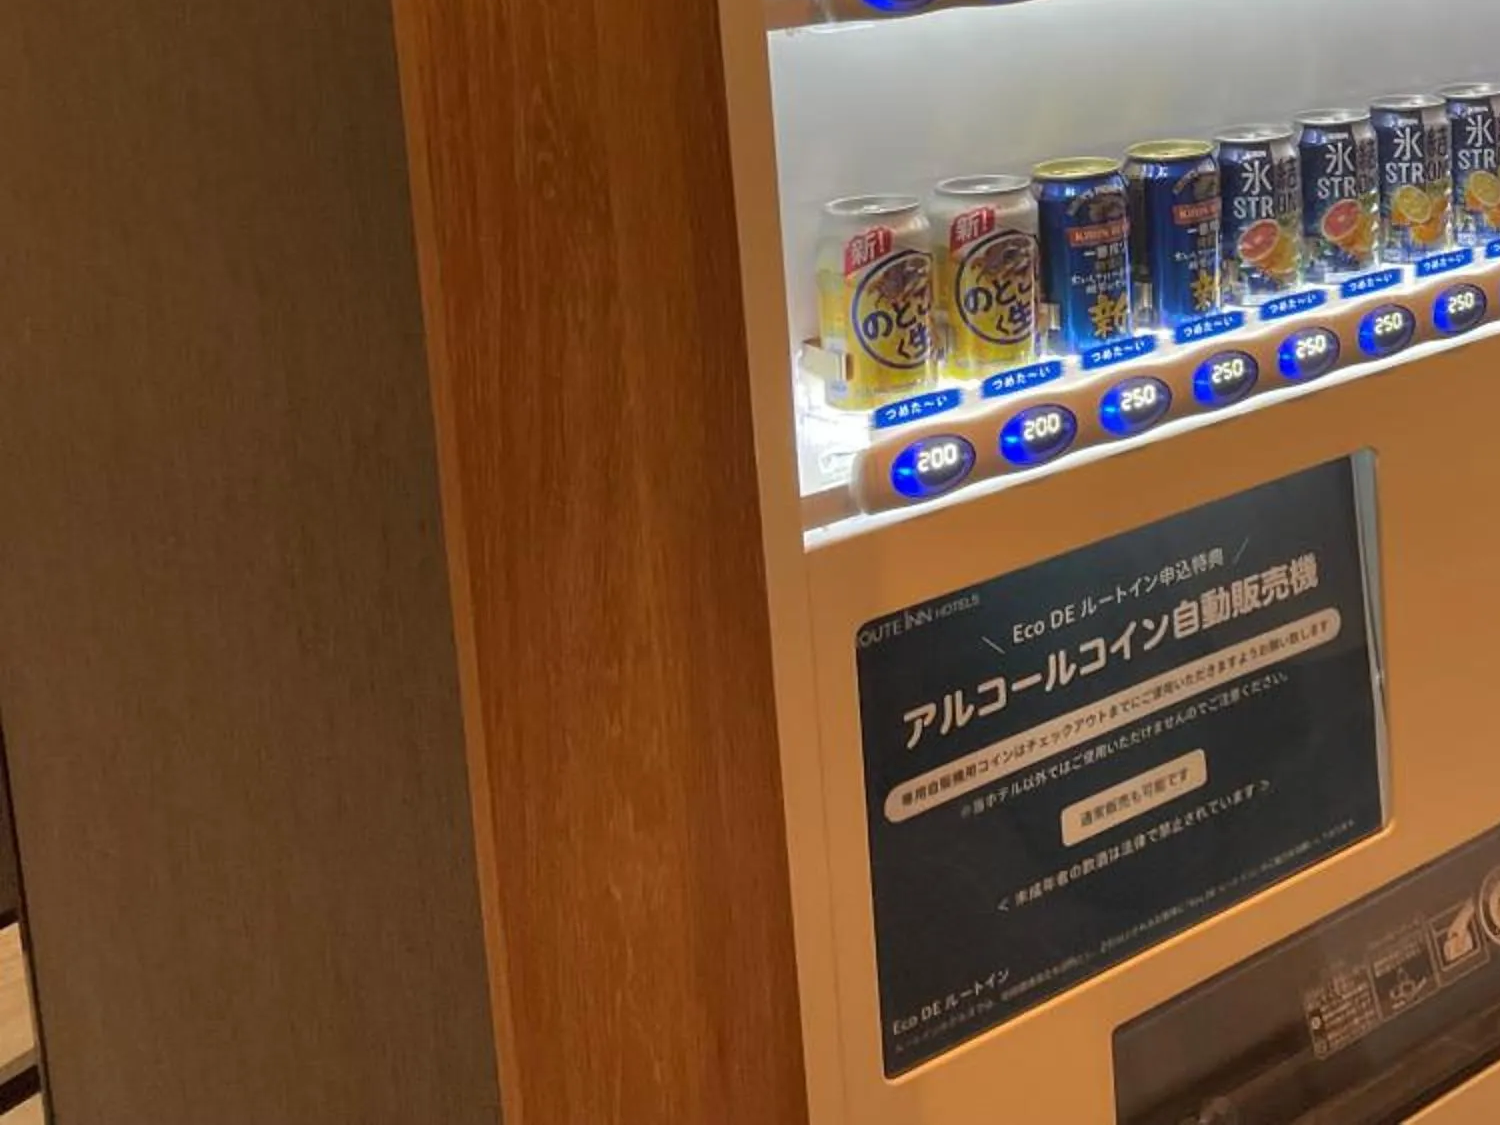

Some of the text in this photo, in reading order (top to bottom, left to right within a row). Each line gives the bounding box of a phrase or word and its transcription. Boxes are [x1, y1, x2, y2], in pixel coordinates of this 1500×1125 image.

[1393, 126, 1425, 161] 氷
[1465, 113, 1494, 148] 氷
[1324, 142, 1354, 175] 氷
[1385, 161, 1426, 184] STR
[1457, 147, 1497, 171] STR
[1241, 160, 1273, 195] 氷
[1316, 176, 1358, 200] STR
[1233, 195, 1274, 219] STR
[1447, 291, 1476, 313] 250
[1375, 312, 1404, 335] 250
[1295, 334, 1328, 359] 250
[1212, 359, 1245, 383] 250
[1120, 385, 1157, 412] 250
[1023, 413, 1061, 442] 200
[916, 445, 958, 473] 200
[1012, 546, 1225, 645] Eco DE ルートイン申込特典
[857, 620, 902, 649] OUTE
[903, 551, 1320, 751] アルコールコイン自動販売機
[1079, 766, 1189, 828] 通常販売も可能です
